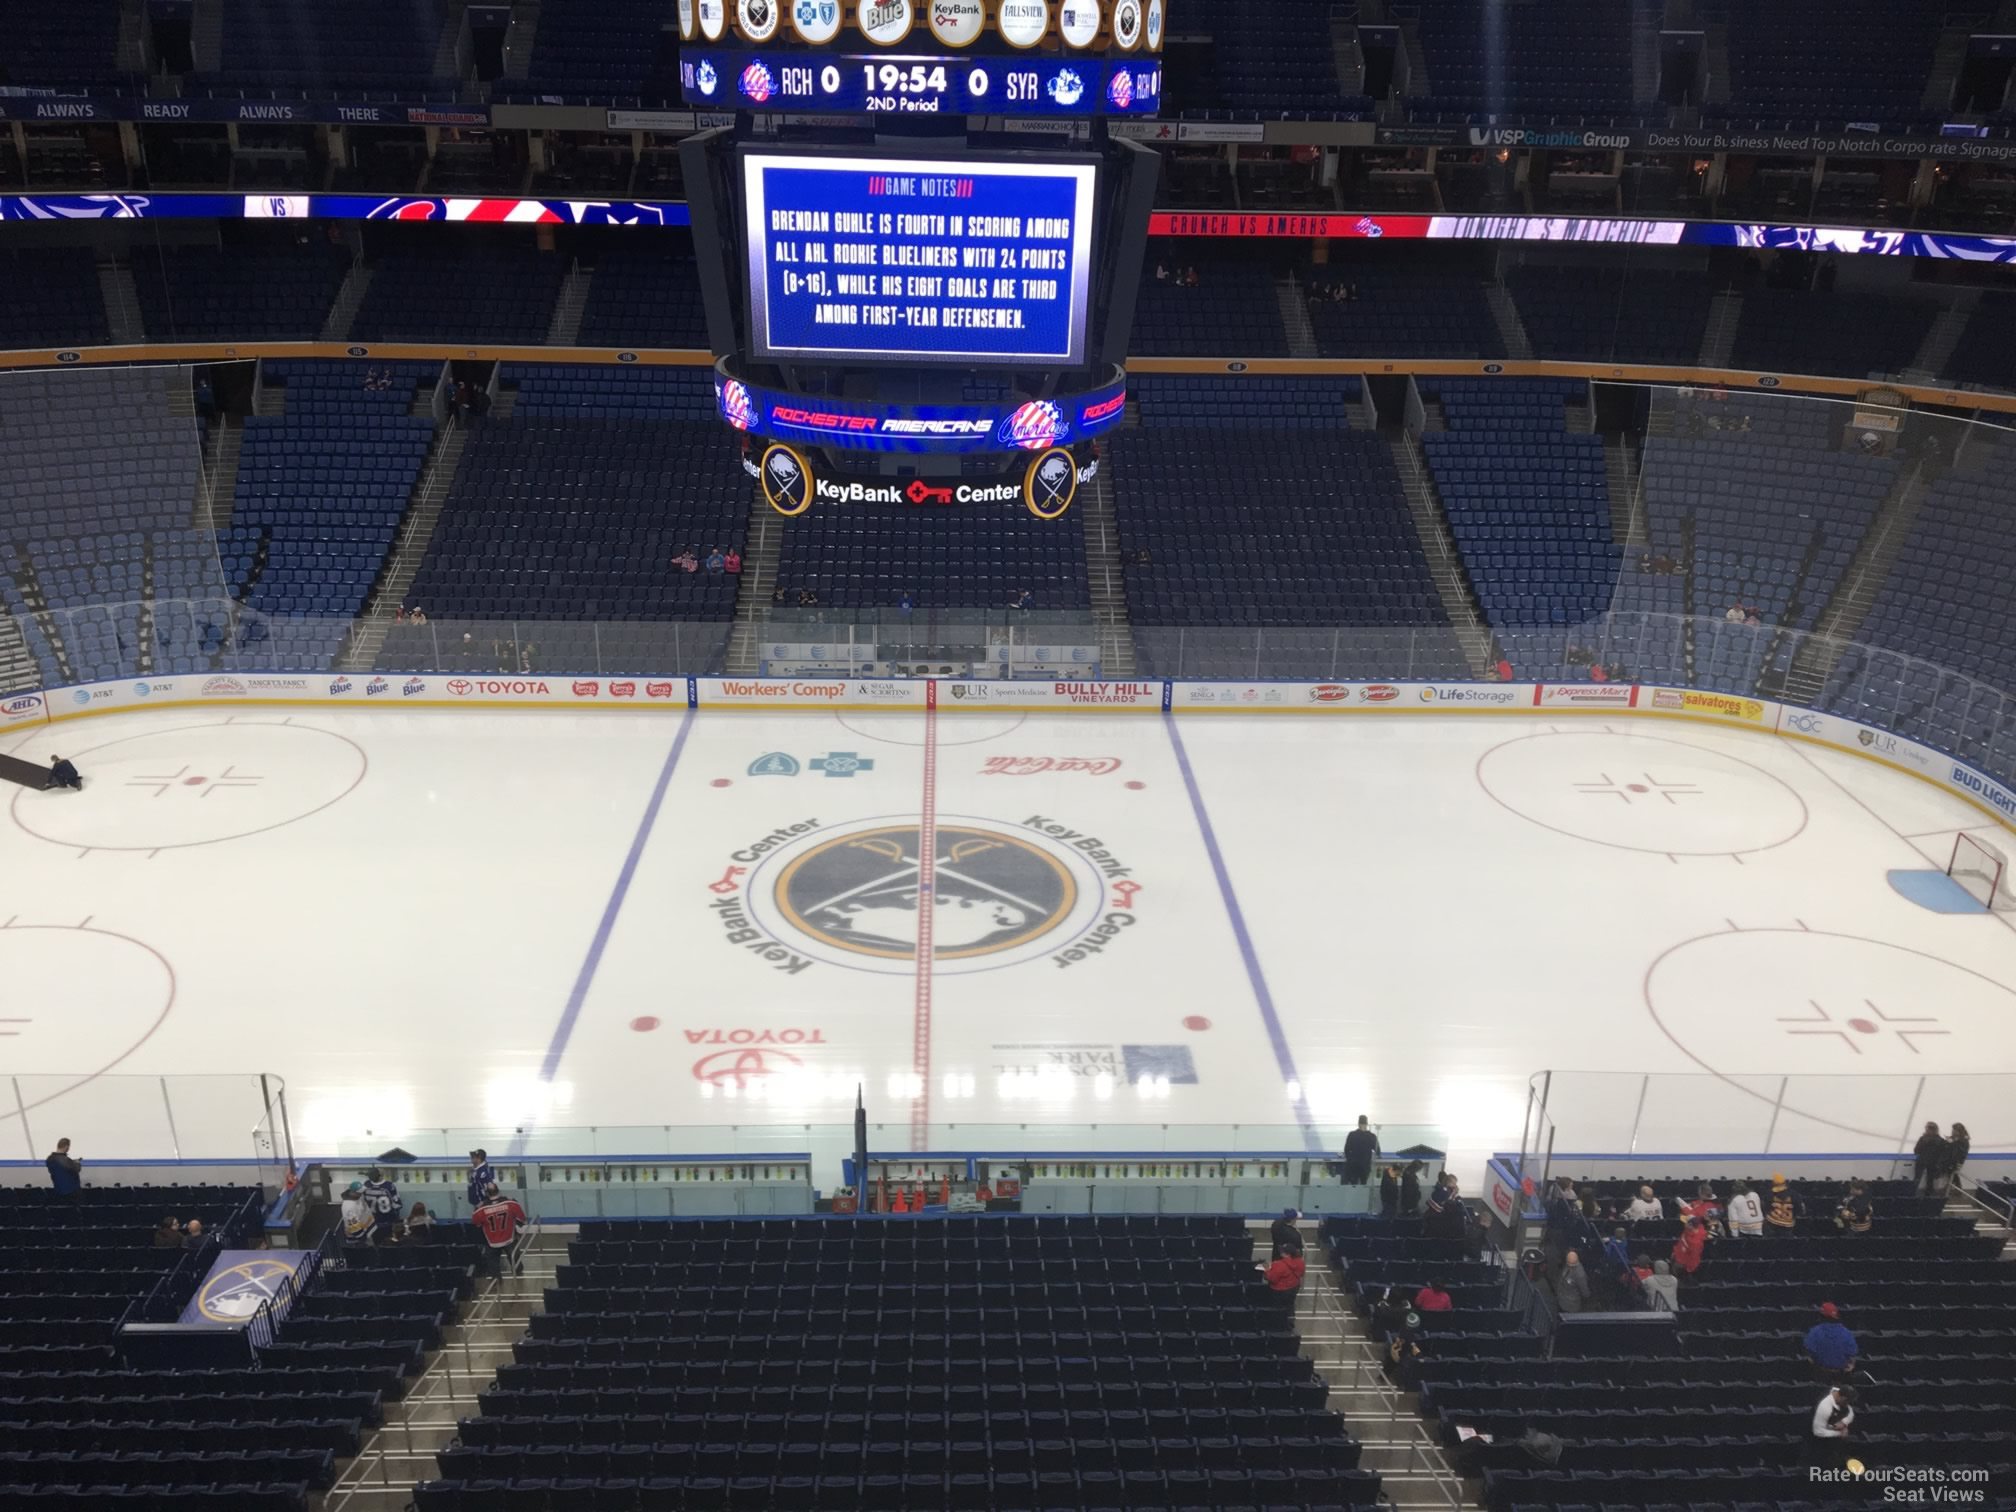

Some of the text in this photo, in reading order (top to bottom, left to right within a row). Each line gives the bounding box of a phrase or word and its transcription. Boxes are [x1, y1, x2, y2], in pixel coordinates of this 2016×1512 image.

[866, 2, 904, 31] Blue
[934, 3, 980, 15] KeyBank
[1004, 5, 1043, 18] FALLSVIEW
[781, 65, 840, 96] RCH 0
[863, 64, 947, 92] 19:54
[968, 68, 988, 96] 0
[1006, 72, 1039, 100] SYR
[36, 104, 94, 118] ALWAYS
[143, 104, 189, 118] READY
[239, 106, 293, 120] ALWAYS
[866, 96, 939, 112] 2ND Period
[338, 107, 380, 122] THERE
[1648, 134, 1680, 146] Does
[1683, 134, 1712, 147] Your
[1773, 137, 1808, 150] Need
[1811, 138, 1836, 152] Top
[1839, 138, 1880, 151] Notch
[1960, 142, 2016, 159] Signage
[886, 177, 957, 197] GAME NOTES
[269, 197, 285, 216] VS
[772, 210, 1069, 239] BRENDAN GUHLE IS FOURTH IN SCORING AMONG
[1170, 216, 1327, 234] CRUNCH VS AMERKS
[776, 242, 1066, 270] ALL AHL ROOKIE BLUELINERS WITH 24 POINTS
[837, 274, 877, 295] WHILE
[882, 276, 902, 296] HIS
[907, 276, 943, 297] EIGHT
[948, 278, 987, 298] GOALS
[992, 279, 1016, 299] ARE
[1022, 279, 1057, 300] THIRD
[815, 304, 1025, 329] AMONG FIRST-YEAR DEFENSEMEN.
[773, 406, 994, 433] ROCHESTER AMERICANS
[816, 479, 1021, 503] KeyBank Center
[93, 690, 114, 699] AT&T
[152, 684, 173, 692] AT&T
[329, 683, 353, 695] Blue
[366, 683, 389, 696] Blue
[402, 684, 425, 696] Blue
[475, 681, 549, 694] TOYOTA
[721, 682, 846, 699] Workers' Comp?
[967, 684, 988, 696] UR
[995, 688, 1016, 696] Sports
[1055, 683, 1152, 696] BULLY HILL
[1557, 687, 1629, 696] Express Mart
[9, 699, 35, 711] AHL
[1685, 693, 1742, 711] salvatores
[1788, 715, 1823, 733] ROC
[1876, 733, 1897, 752] UR
[1952, 767, 2016, 815] BUD LIGHT
[731, 818, 820, 862] Center
[1022, 815, 1132, 879] KeyBank
[709, 896, 814, 975] KeyBank
[1052, 912, 1136, 969] Center
[683, 1029, 827, 1044] TOYOTA
[1047, 1051, 1115, 1064] PARK
[1746, 1199, 1760, 1218] 9
[488, 1211, 508, 1233] 17
